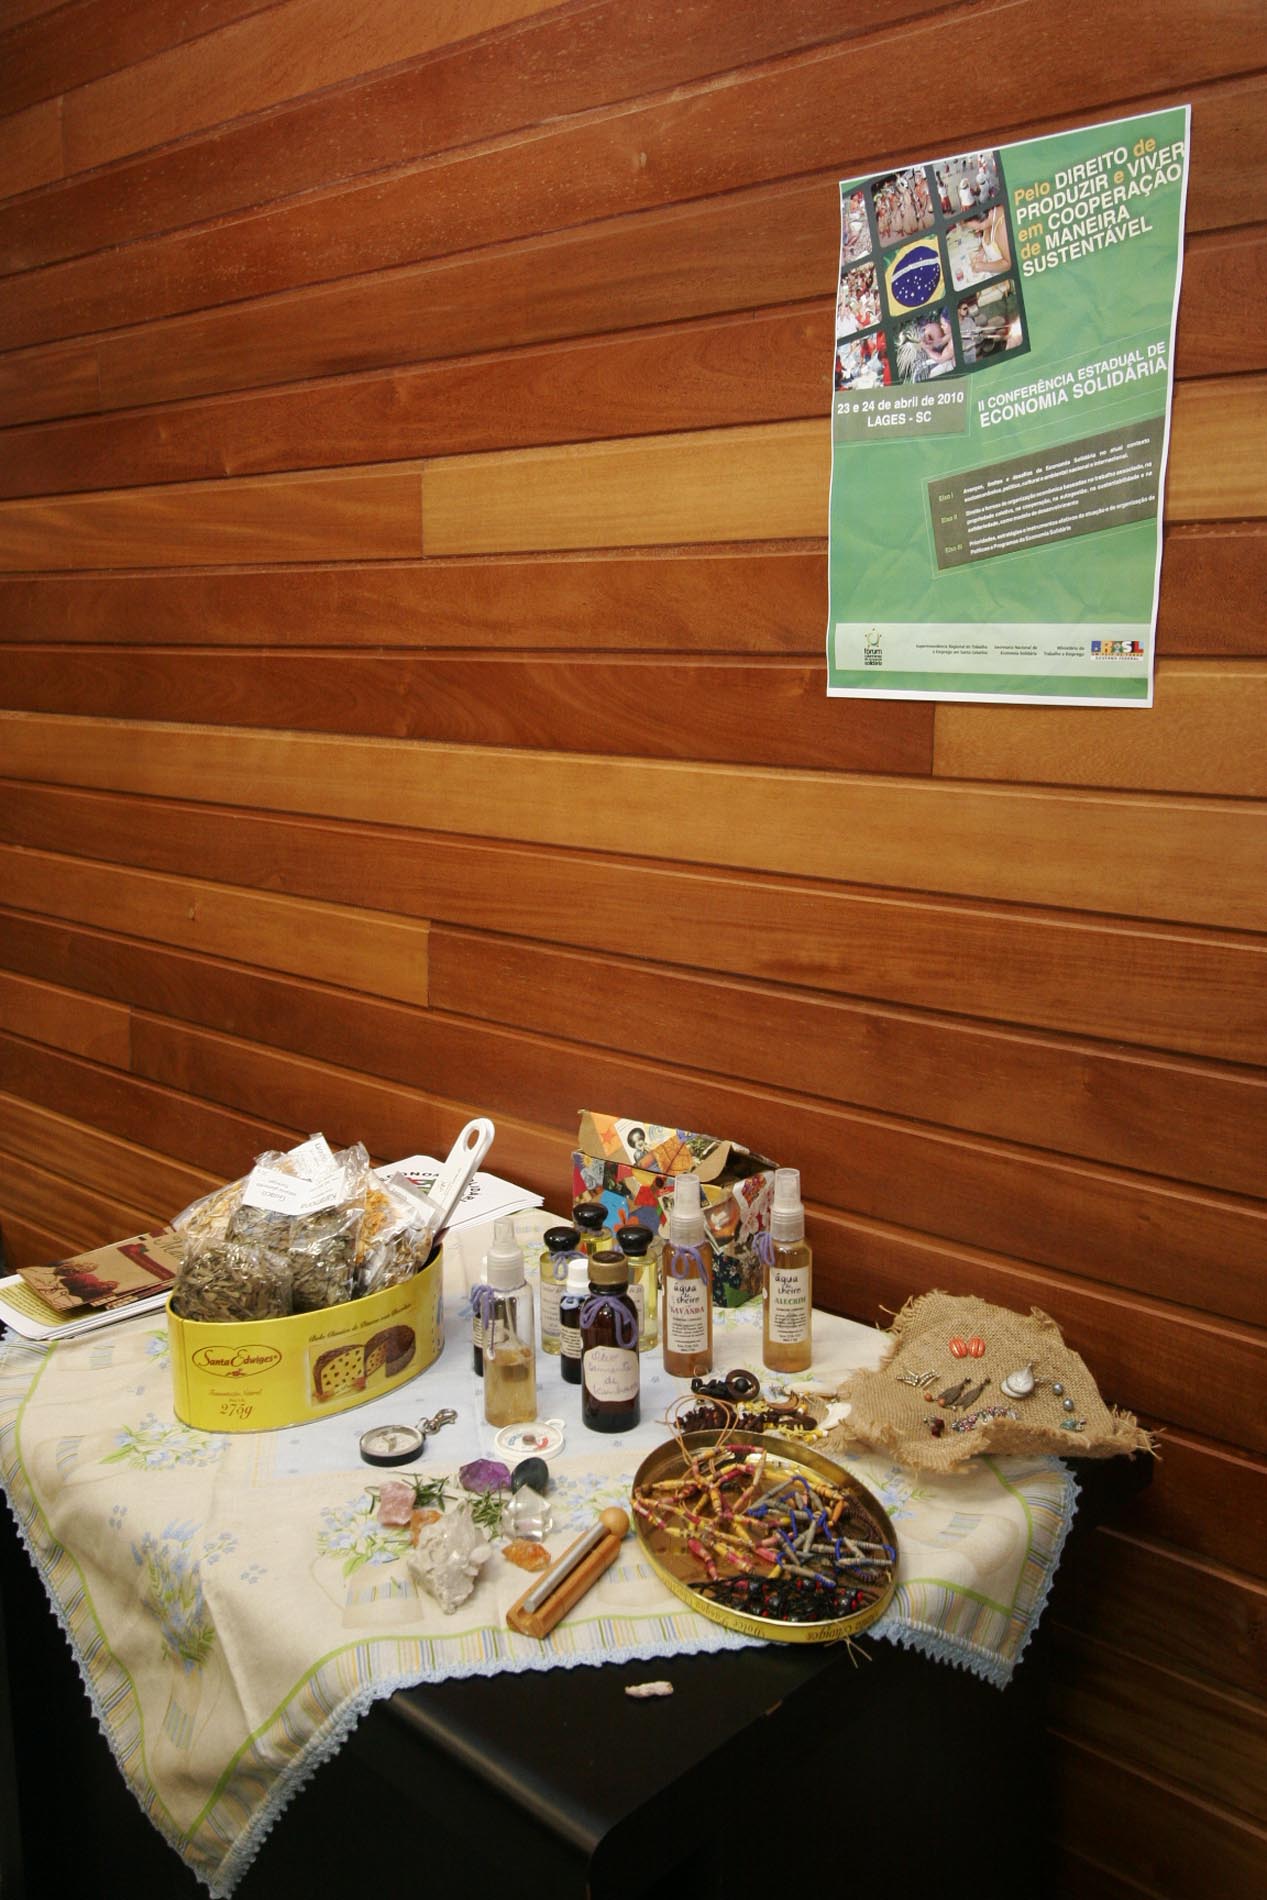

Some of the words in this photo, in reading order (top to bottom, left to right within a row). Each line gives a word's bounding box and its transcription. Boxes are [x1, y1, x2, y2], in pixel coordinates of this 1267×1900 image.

[1014, 182, 1050, 205] Pelo
[1055, 146, 1128, 189] DIREITO
[1134, 138, 1156, 157] de
[1016, 174, 1108, 224] PRODUZIR
[1114, 170, 1124, 184] e
[1127, 142, 1185, 178] VIVER
[1018, 222, 1043, 242] em
[1048, 163, 1181, 230] COOPERAÇÃO
[1020, 242, 1040, 260] de
[1045, 204, 1130, 250] MANEIRA
[1022, 216, 1152, 277] SUSTENTÁVEL
[837, 403, 850, 414] 23
[852, 404, 860, 413] e
[862, 400, 875, 412] 24
[878, 398, 892, 411] de
[894, 396, 918, 409] abril
[921, 394, 934, 407] de
[937, 391, 964, 405] 2010
[978, 400, 985, 412] II
[988, 374, 1074, 410] CONFERÊNCIA
[1078, 352, 1144, 380] ESTADUAL
[1147, 342, 1166, 358] DE
[980, 392, 1068, 428] ECONOMIA
[1073, 356, 1168, 400] SOLIDÁRIA
[867, 414, 906, 428] LAGES
[916, 411, 932, 424] SC
[674, 1282, 696, 1296] água
[775, 1272, 798, 1285] água
[198, 1348, 231, 1367] Santa
[231, 1348, 274, 1368] Edwiges
[220, 1403, 254, 1420] 275g
